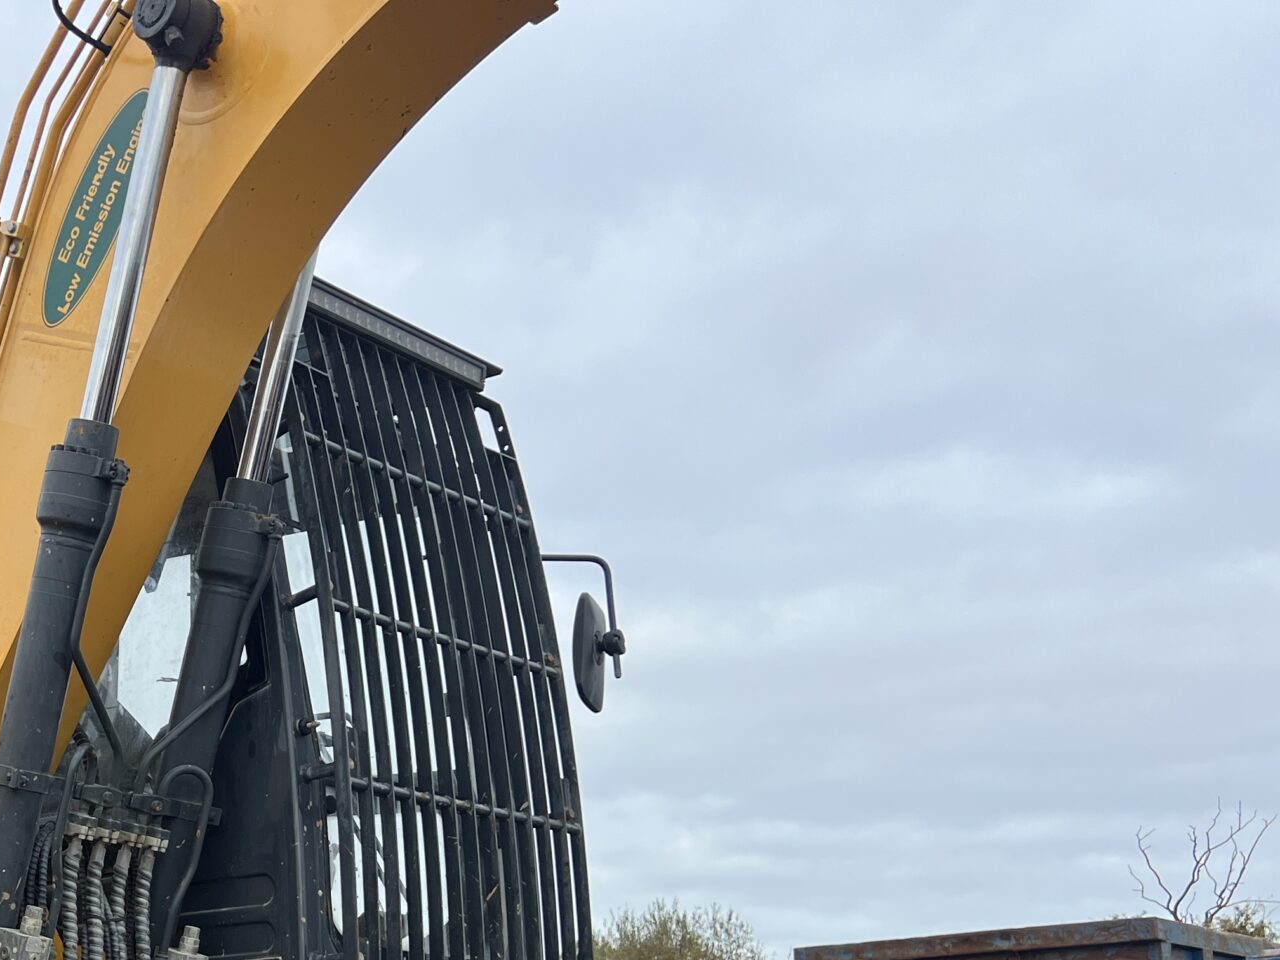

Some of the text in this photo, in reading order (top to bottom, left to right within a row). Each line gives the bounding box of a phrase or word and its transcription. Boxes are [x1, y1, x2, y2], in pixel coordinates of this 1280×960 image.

[57, 108, 145, 316] Low Emission Engin
[58, 143, 116, 264] Eco Friendly
